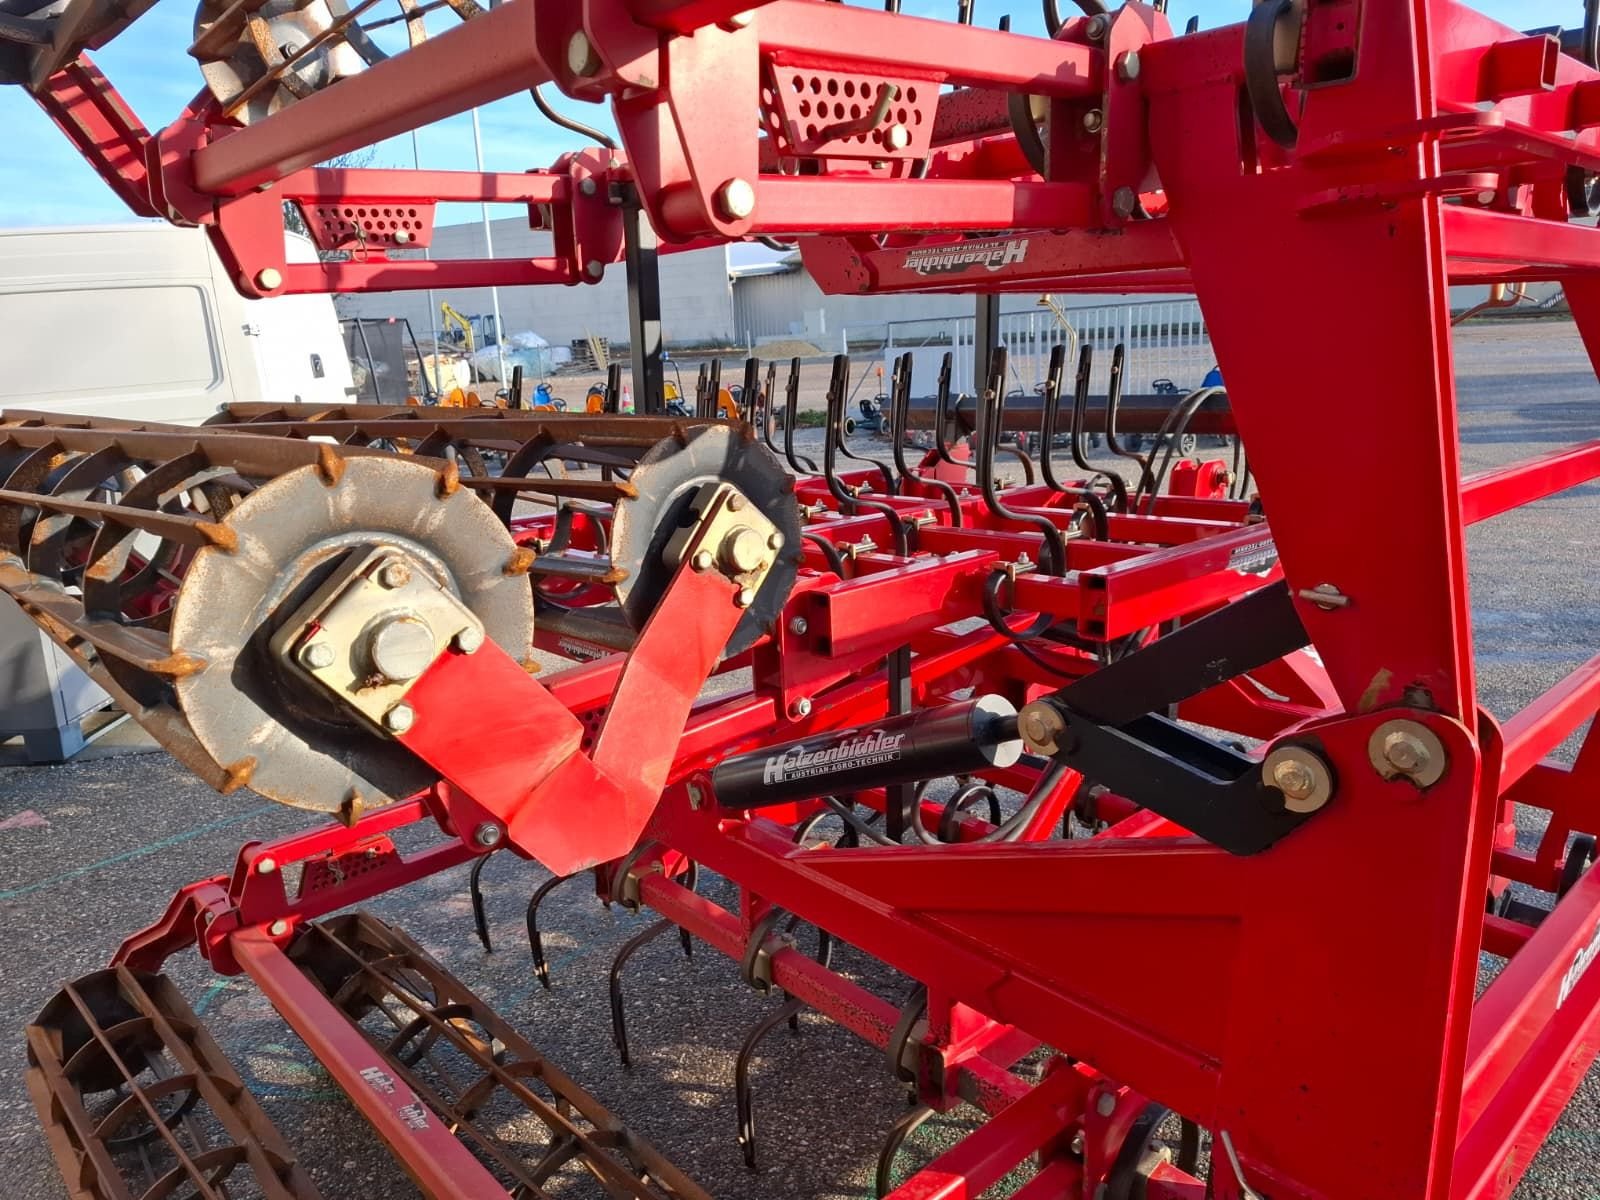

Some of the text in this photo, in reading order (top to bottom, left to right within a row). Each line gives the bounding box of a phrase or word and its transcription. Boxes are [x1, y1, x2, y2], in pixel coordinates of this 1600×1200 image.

[903, 239, 1029, 275] Hatzenbichler
[764, 729, 905, 785] Hatzenbichler
[791, 753, 895, 779] AUSTRIAN-AGRO-TECHNIK
